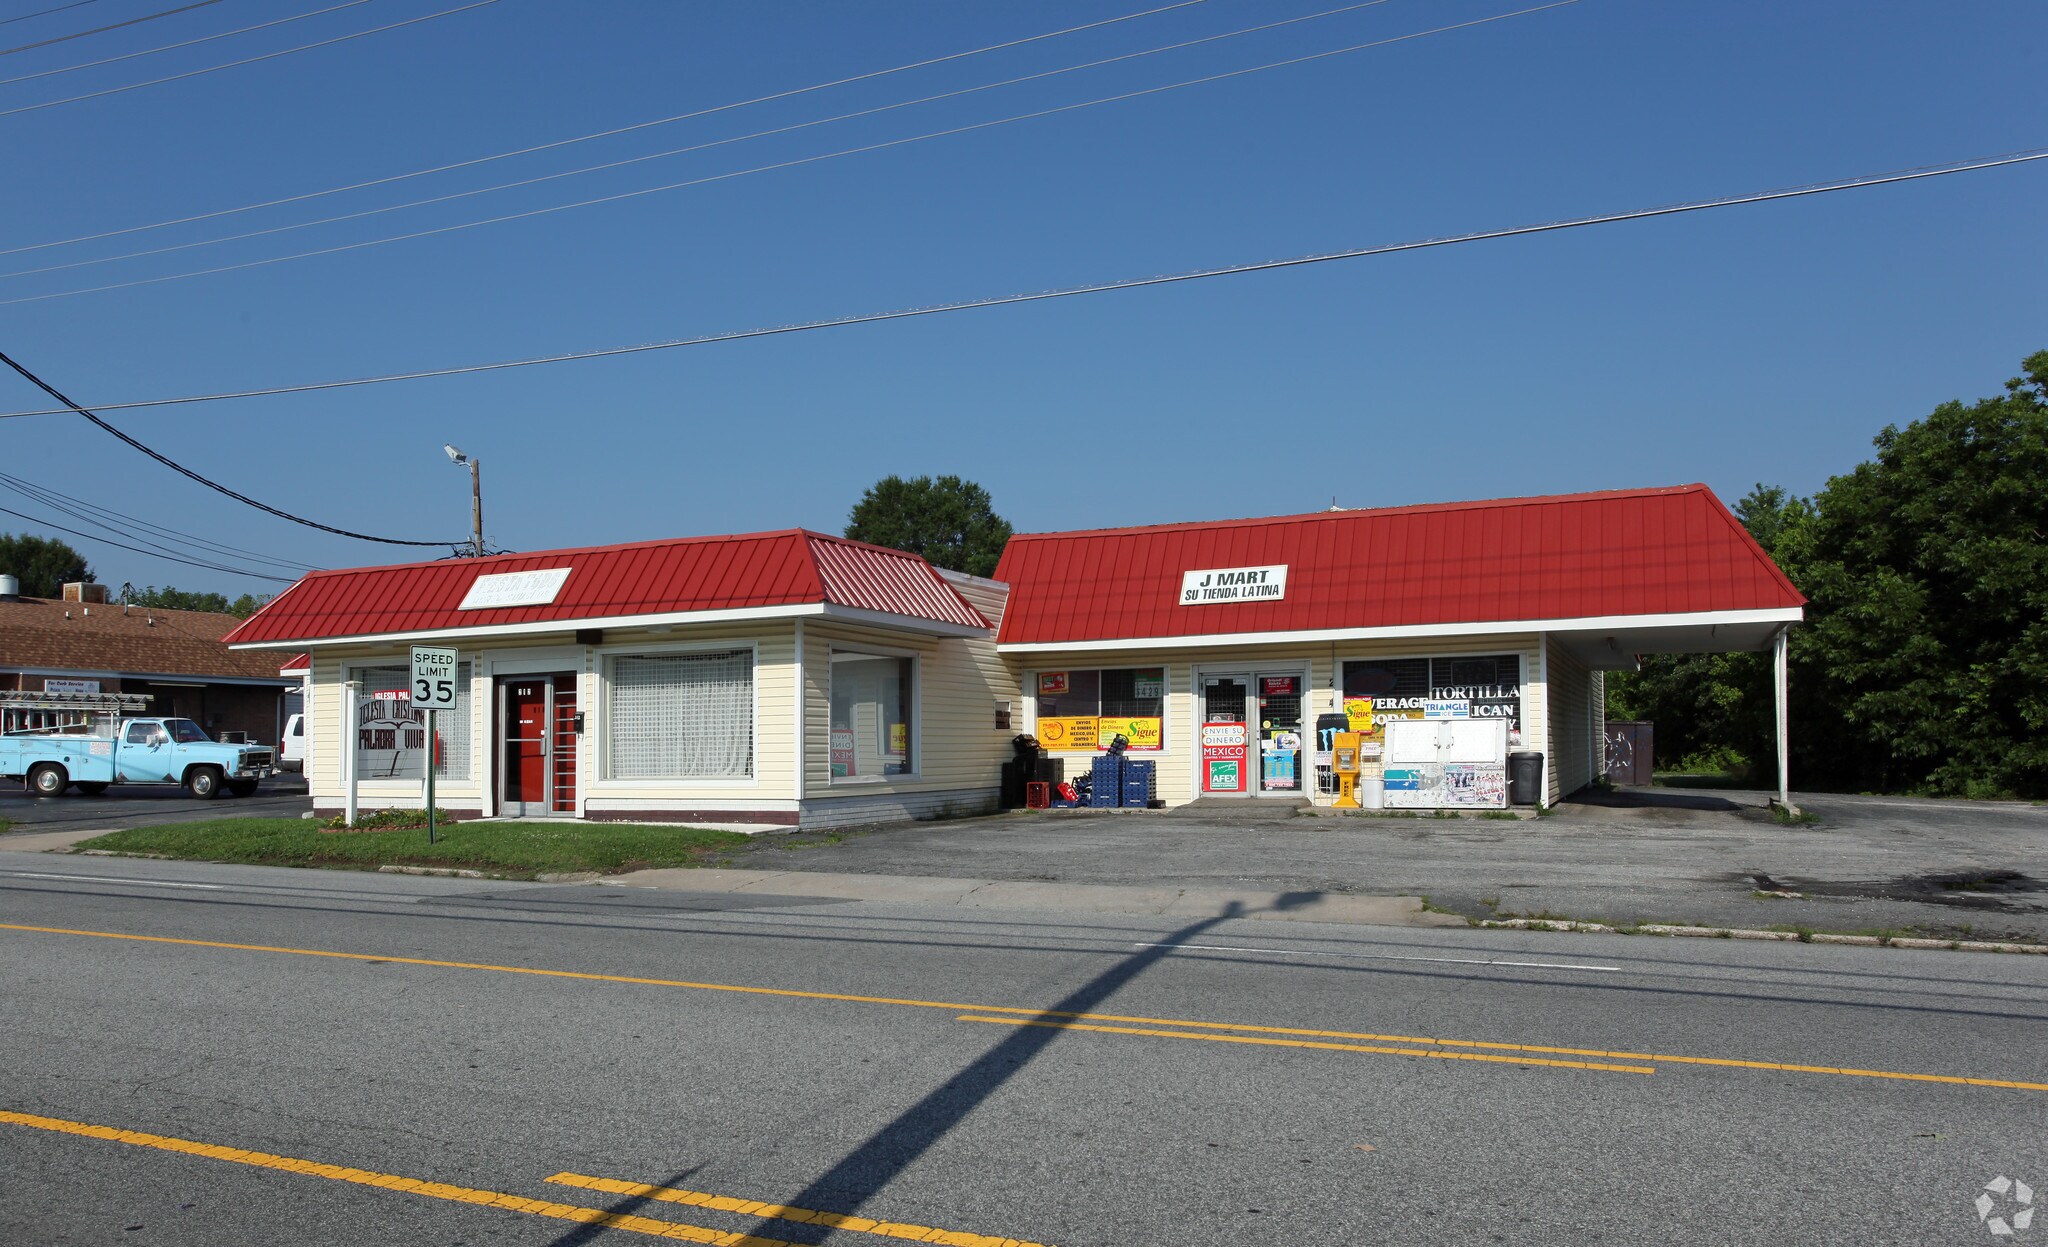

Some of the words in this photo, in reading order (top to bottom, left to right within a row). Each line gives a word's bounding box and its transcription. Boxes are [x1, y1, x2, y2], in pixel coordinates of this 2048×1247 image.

[1200, 574, 1212, 587] J
[1217, 570, 1270, 586] MART
[1185, 589, 1199, 601] SU
[1203, 587, 1238, 600] TIENDA
[1242, 584, 1280, 597] LATINA
[415, 653, 453, 664] SPEED
[418, 667, 449, 677] LIMIT
[375, 692, 397, 700] IGLESIA
[415, 679, 453, 702] 35
[1432, 684, 1520, 700] TORTILLA
[1345, 704, 1370, 719] Sigue
[1425, 703, 1468, 711] TRIANGLE
[1471, 705, 1513, 717] ICAN
[1127, 721, 1158, 739] Sigue
[359, 729, 396, 750] PALABRA
[1206, 736, 1242, 744] DINERO
[1204, 747, 1244, 756] MEXICO
[1212, 774, 1236, 783] AFEX
